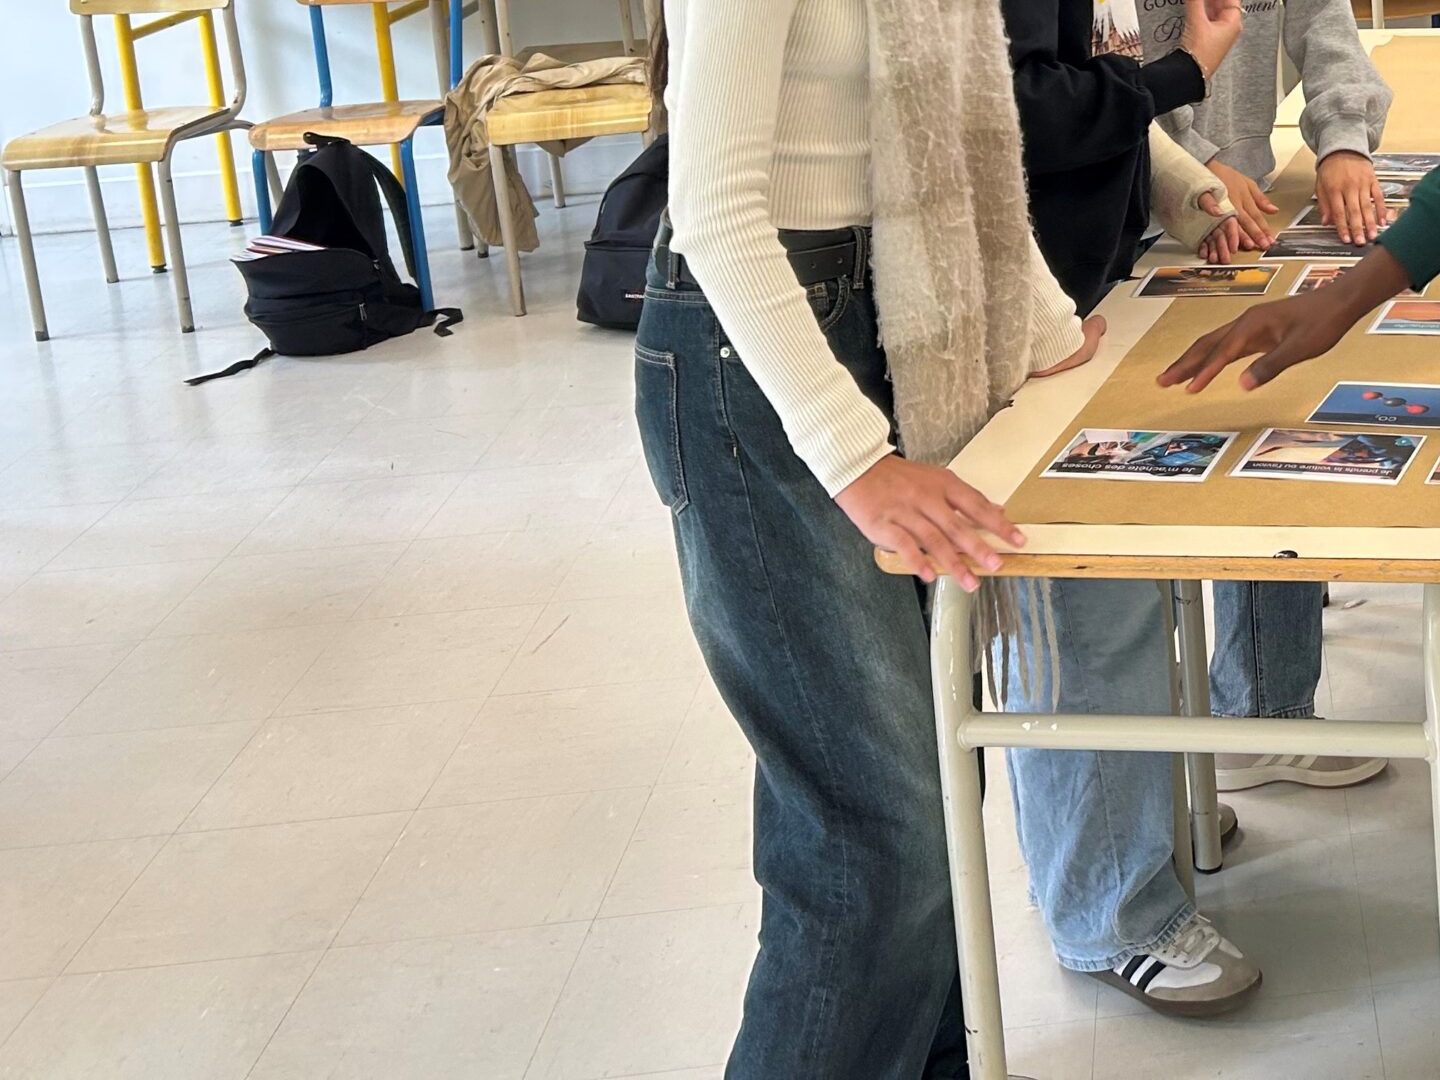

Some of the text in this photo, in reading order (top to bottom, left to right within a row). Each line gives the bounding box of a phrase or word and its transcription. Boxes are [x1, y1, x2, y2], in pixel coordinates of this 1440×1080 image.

[1061, 462, 1196, 474] Je m'achète des choses
[1252, 462, 1283, 470] l'avion
[1299, 464, 1331, 472] voiture
[1345, 466, 1379, 475] prends
[1381, 468, 1393, 476] Je
